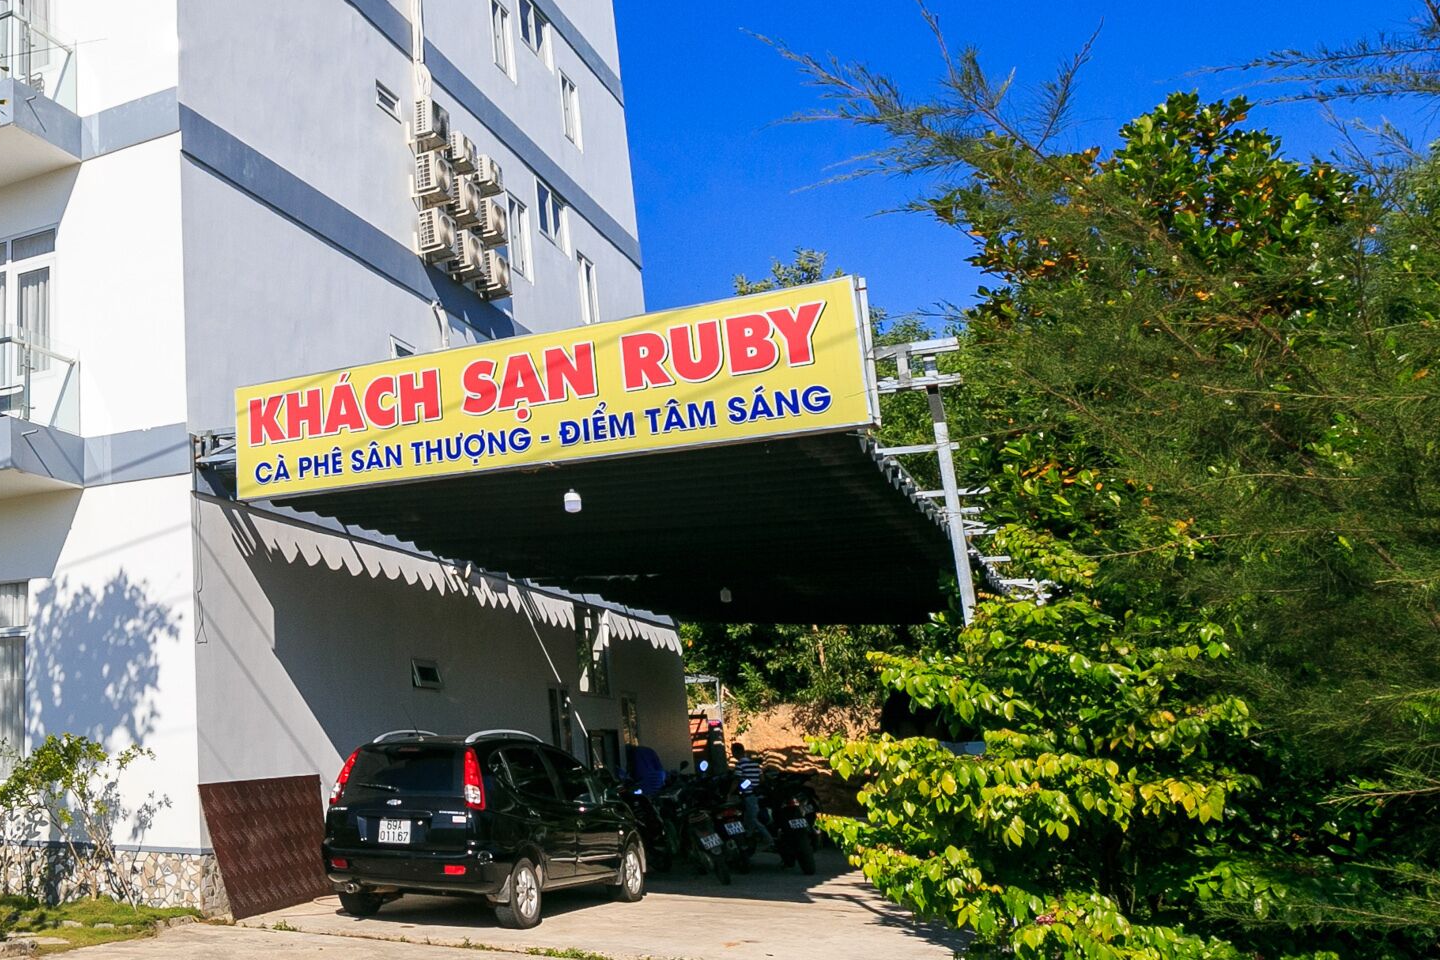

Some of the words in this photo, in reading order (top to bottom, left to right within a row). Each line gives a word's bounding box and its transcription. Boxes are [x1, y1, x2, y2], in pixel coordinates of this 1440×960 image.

[250, 368, 442, 446] KHÁCH
[462, 341, 598, 422] SẠN
[620, 300, 826, 392] RUBY
[255, 454, 291, 485] CÀ
[299, 446, 343, 478] PHÊ
[351, 441, 402, 470] SÂN
[411, 427, 532, 465] THƯỢNG
[560, 402, 636, 446] ĐIỂM
[645, 398, 716, 433] TÂM
[728, 385, 832, 423] SÁNG
